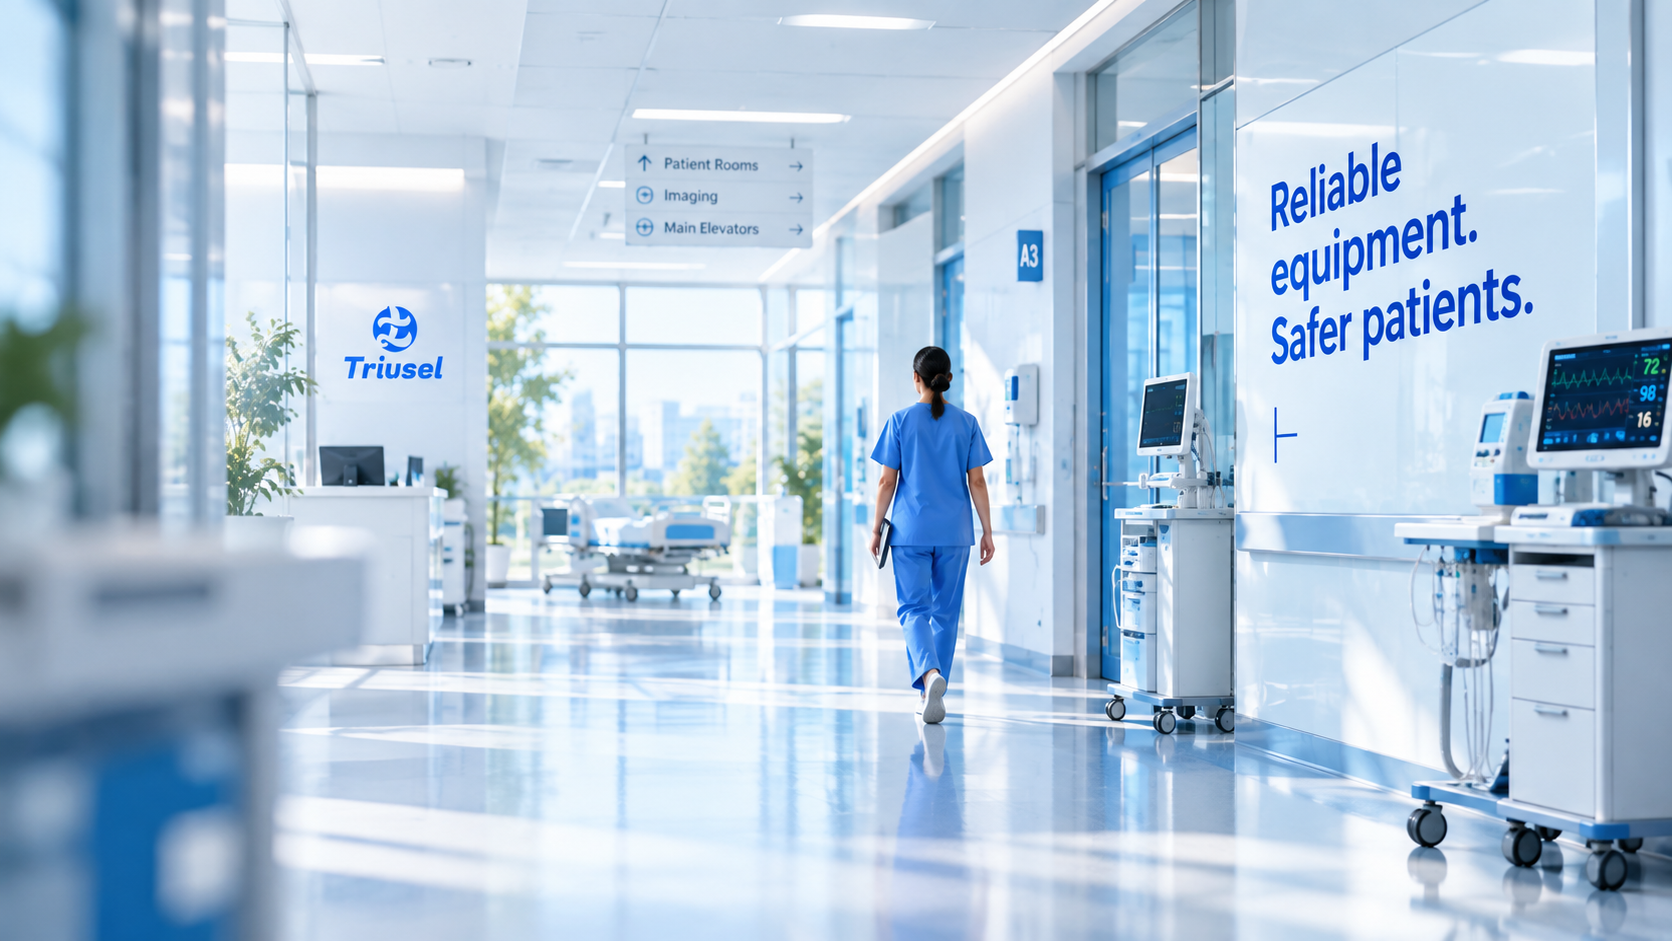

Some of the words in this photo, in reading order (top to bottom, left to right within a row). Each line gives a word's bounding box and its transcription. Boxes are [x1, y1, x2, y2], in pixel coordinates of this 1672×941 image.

[664, 157, 711, 170] Patient
[715, 158, 759, 171] Rooms
[1271, 142, 1402, 231] Reliable
[664, 189, 718, 205] Imaging
[664, 221, 696, 234] Main
[700, 222, 759, 235] Elevators
[1020, 243, 1039, 268] A3
[1271, 195, 1478, 301] equipment.
[1271, 306, 1352, 364] Safer
[1363, 269, 1534, 361] patients.
[344, 355, 443, 379] Triusel
[1643, 357, 1660, 375] 72
[1639, 384, 1657, 402] 98
[1637, 411, 1652, 428] 16
